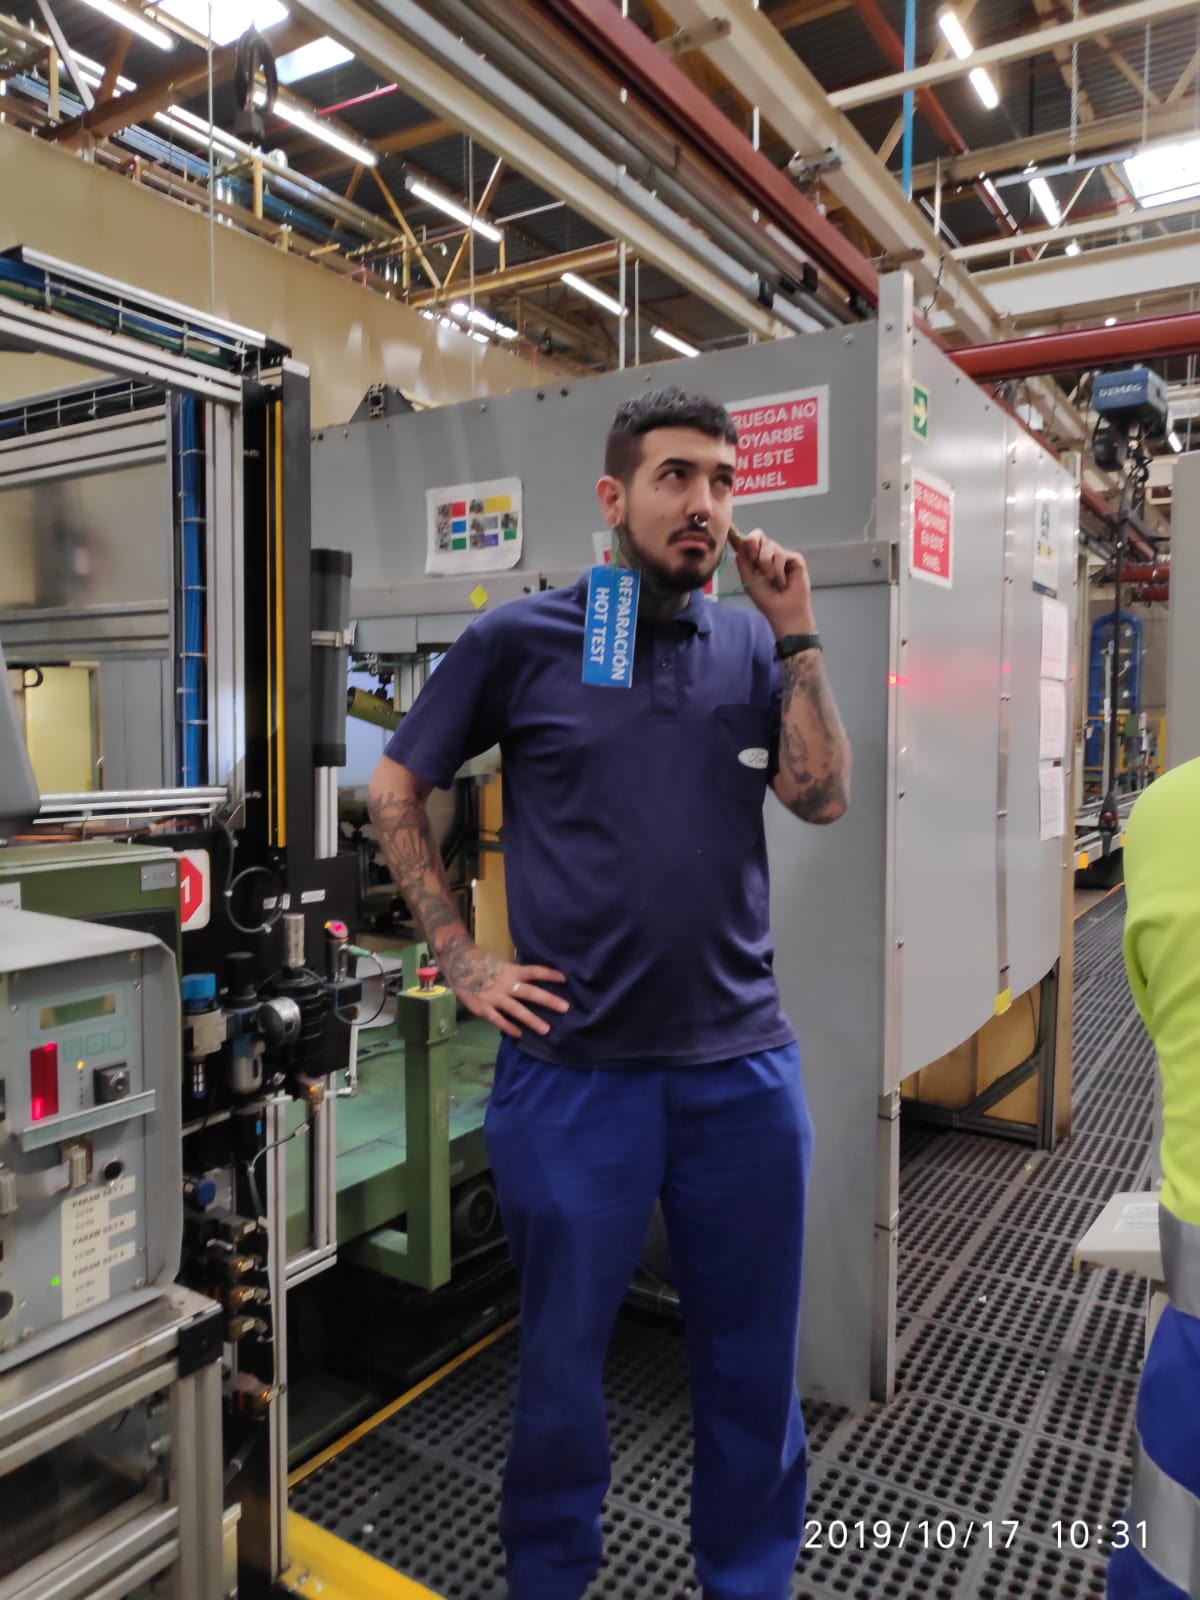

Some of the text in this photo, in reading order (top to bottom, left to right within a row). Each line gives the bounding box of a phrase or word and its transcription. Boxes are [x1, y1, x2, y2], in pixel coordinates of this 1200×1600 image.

[791, 402, 817, 420] NO
[738, 425, 805, 450] OYARSE
[737, 448, 795, 471] N ESTE
[734, 472, 787, 492] PANEL
[590, 587, 610, 665] HOT TEST
[610, 575, 634, 681] REPARACIÓN
